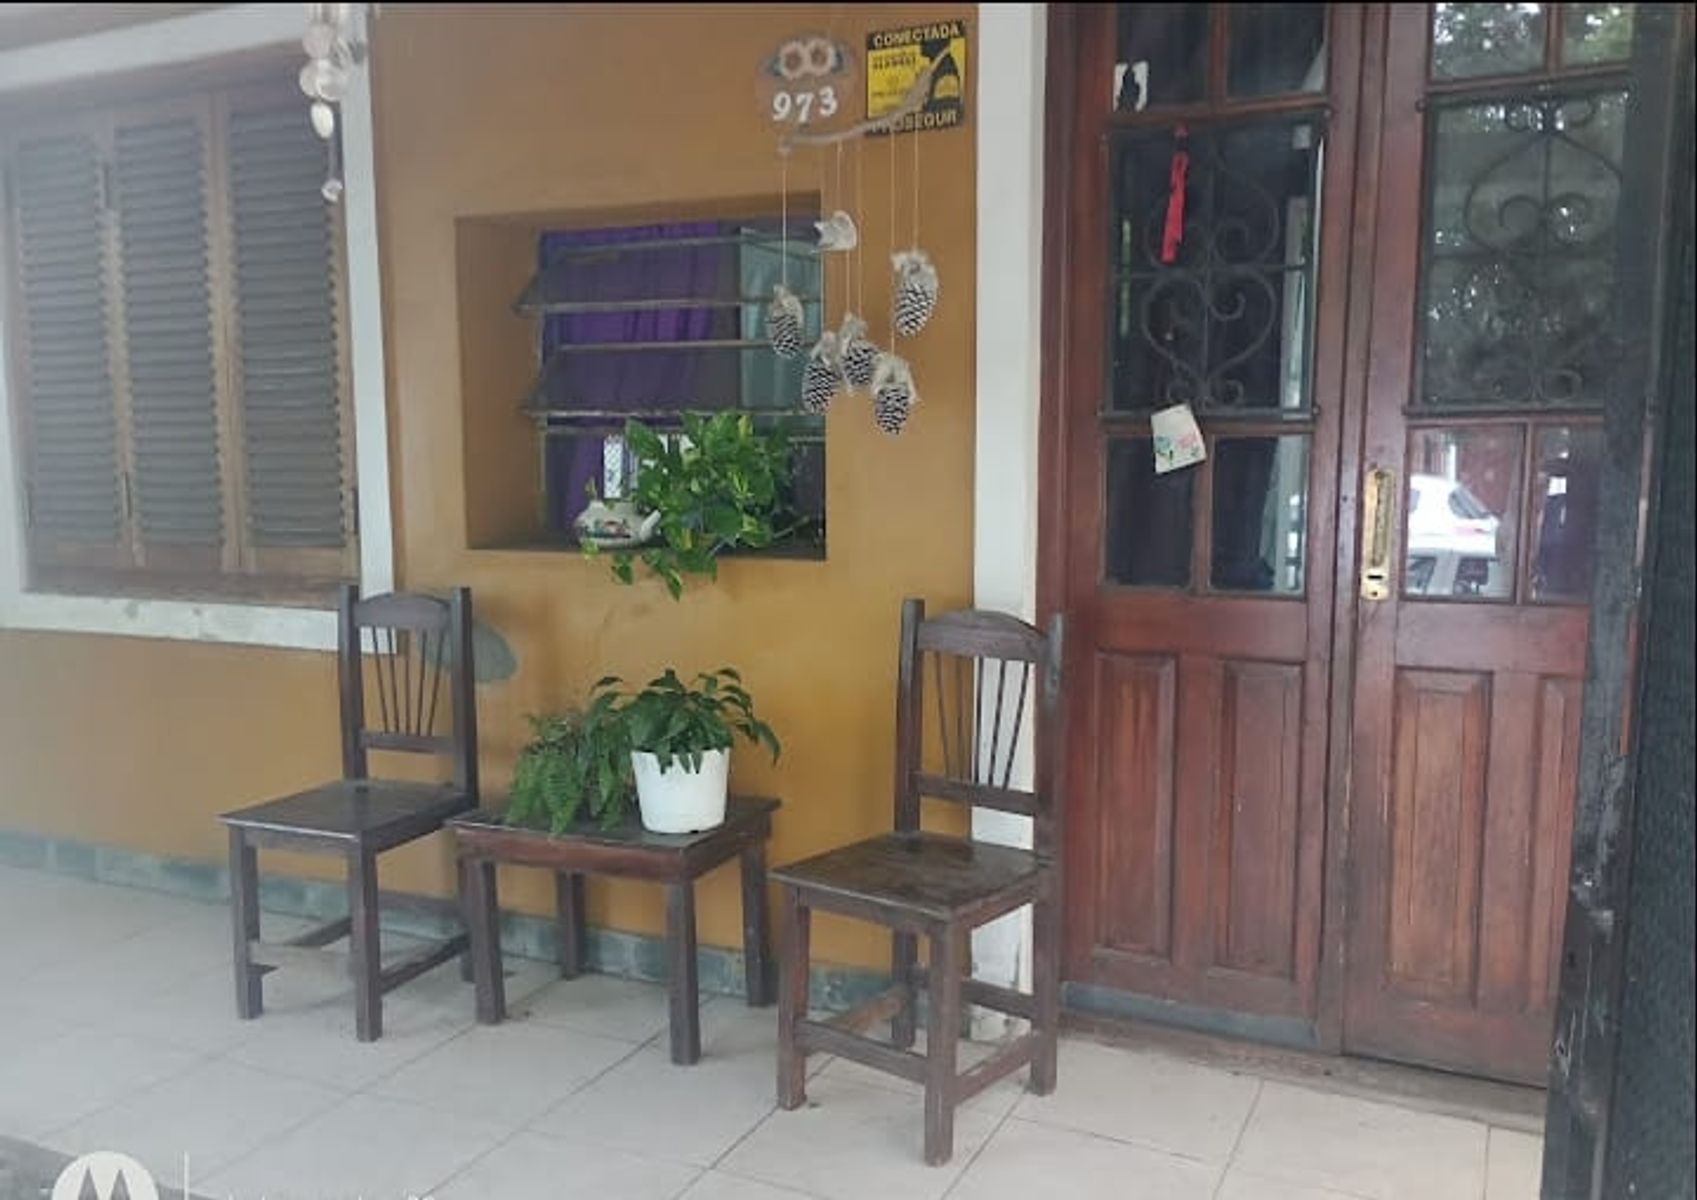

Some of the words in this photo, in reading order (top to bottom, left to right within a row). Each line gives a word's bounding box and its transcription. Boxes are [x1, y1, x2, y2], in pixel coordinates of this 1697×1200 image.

[873, 23, 960, 46] CONECTADA
[772, 85, 839, 123] 973
[871, 110, 957, 134] OSEGUR
